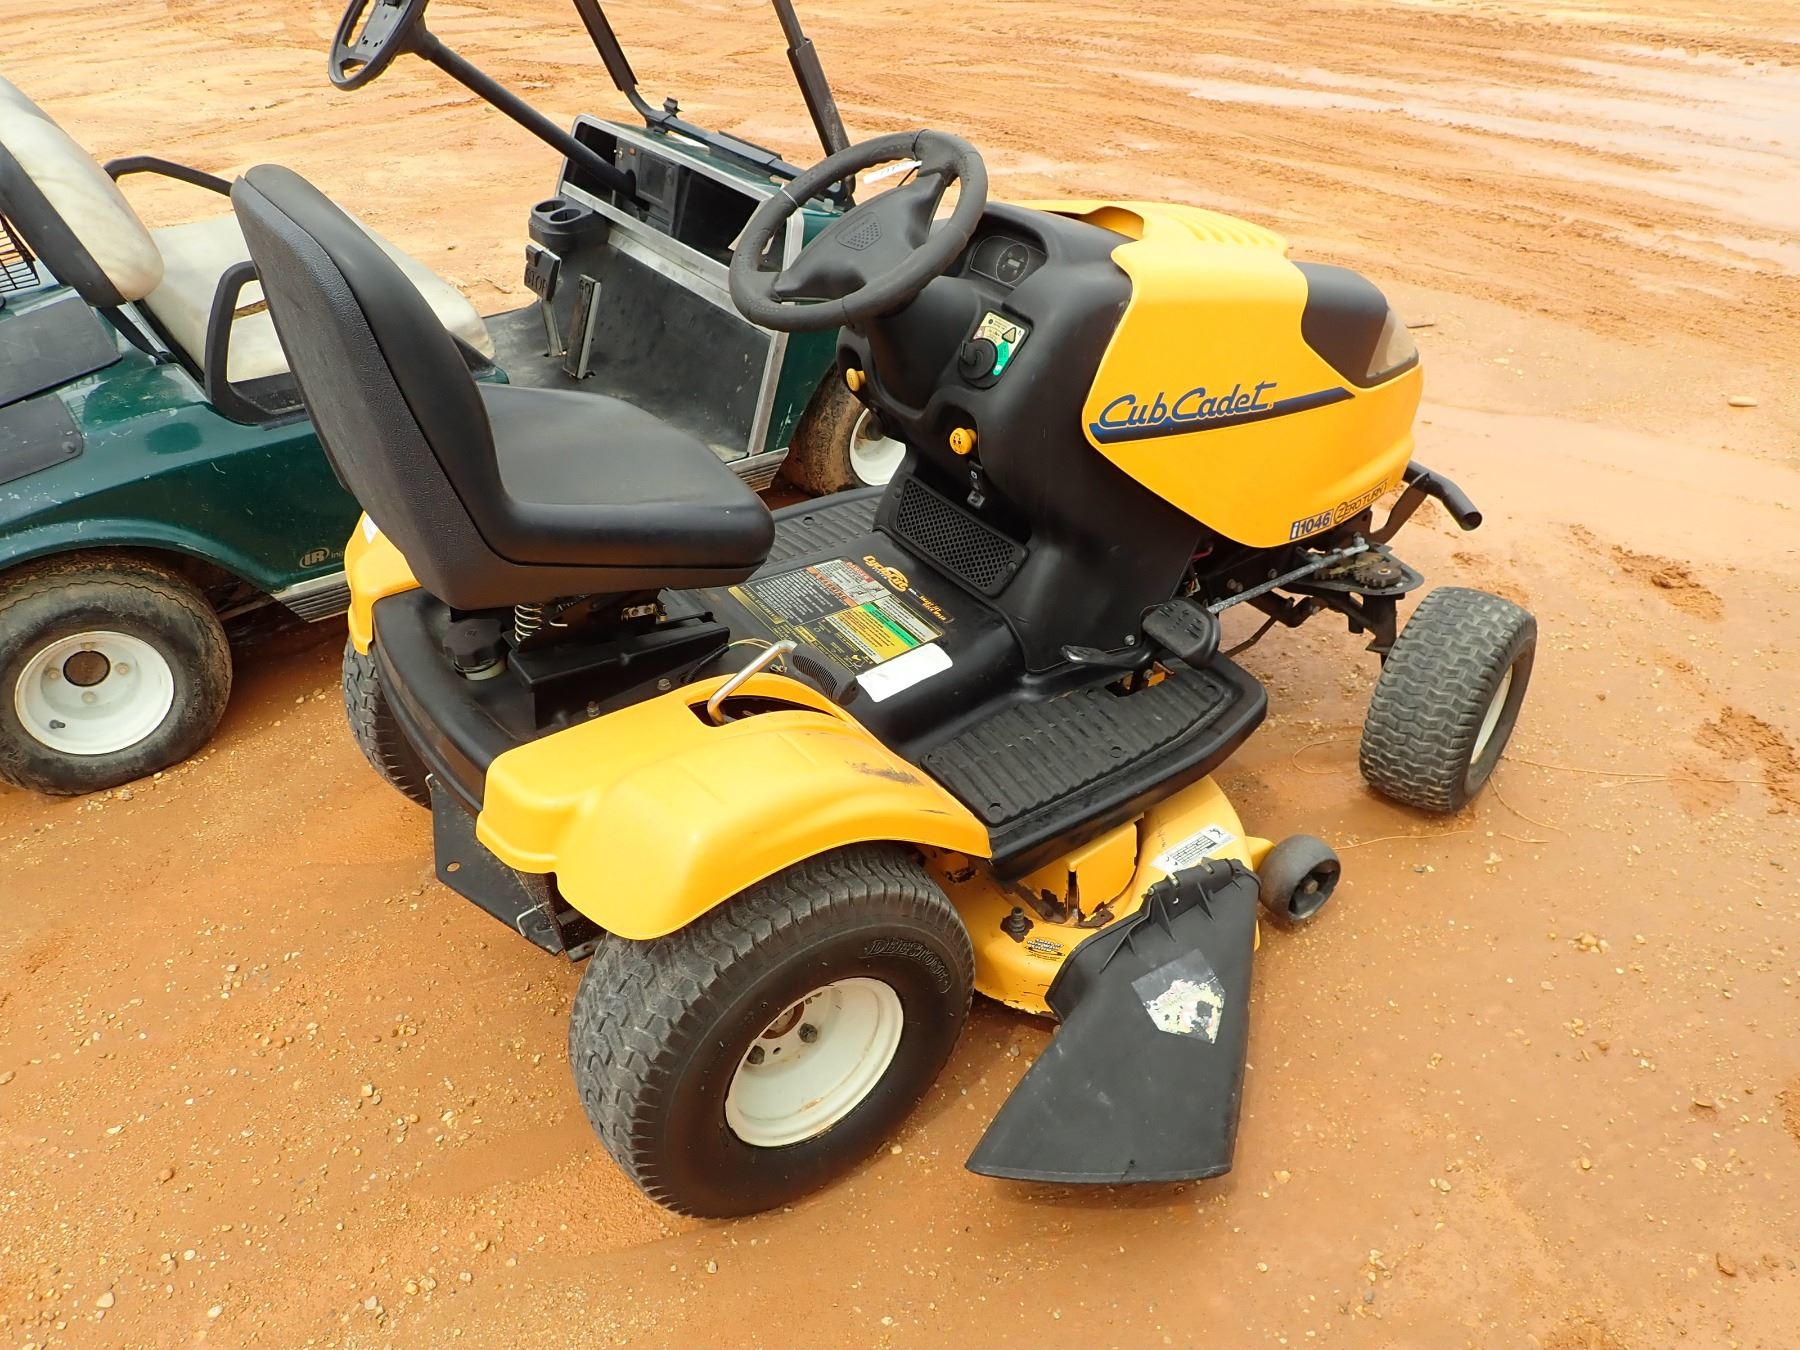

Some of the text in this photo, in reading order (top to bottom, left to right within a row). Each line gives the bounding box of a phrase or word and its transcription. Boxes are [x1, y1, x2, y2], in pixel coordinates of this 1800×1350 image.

[526, 268, 547, 293] STOP
[1099, 381, 1277, 428] Cub Cadet
